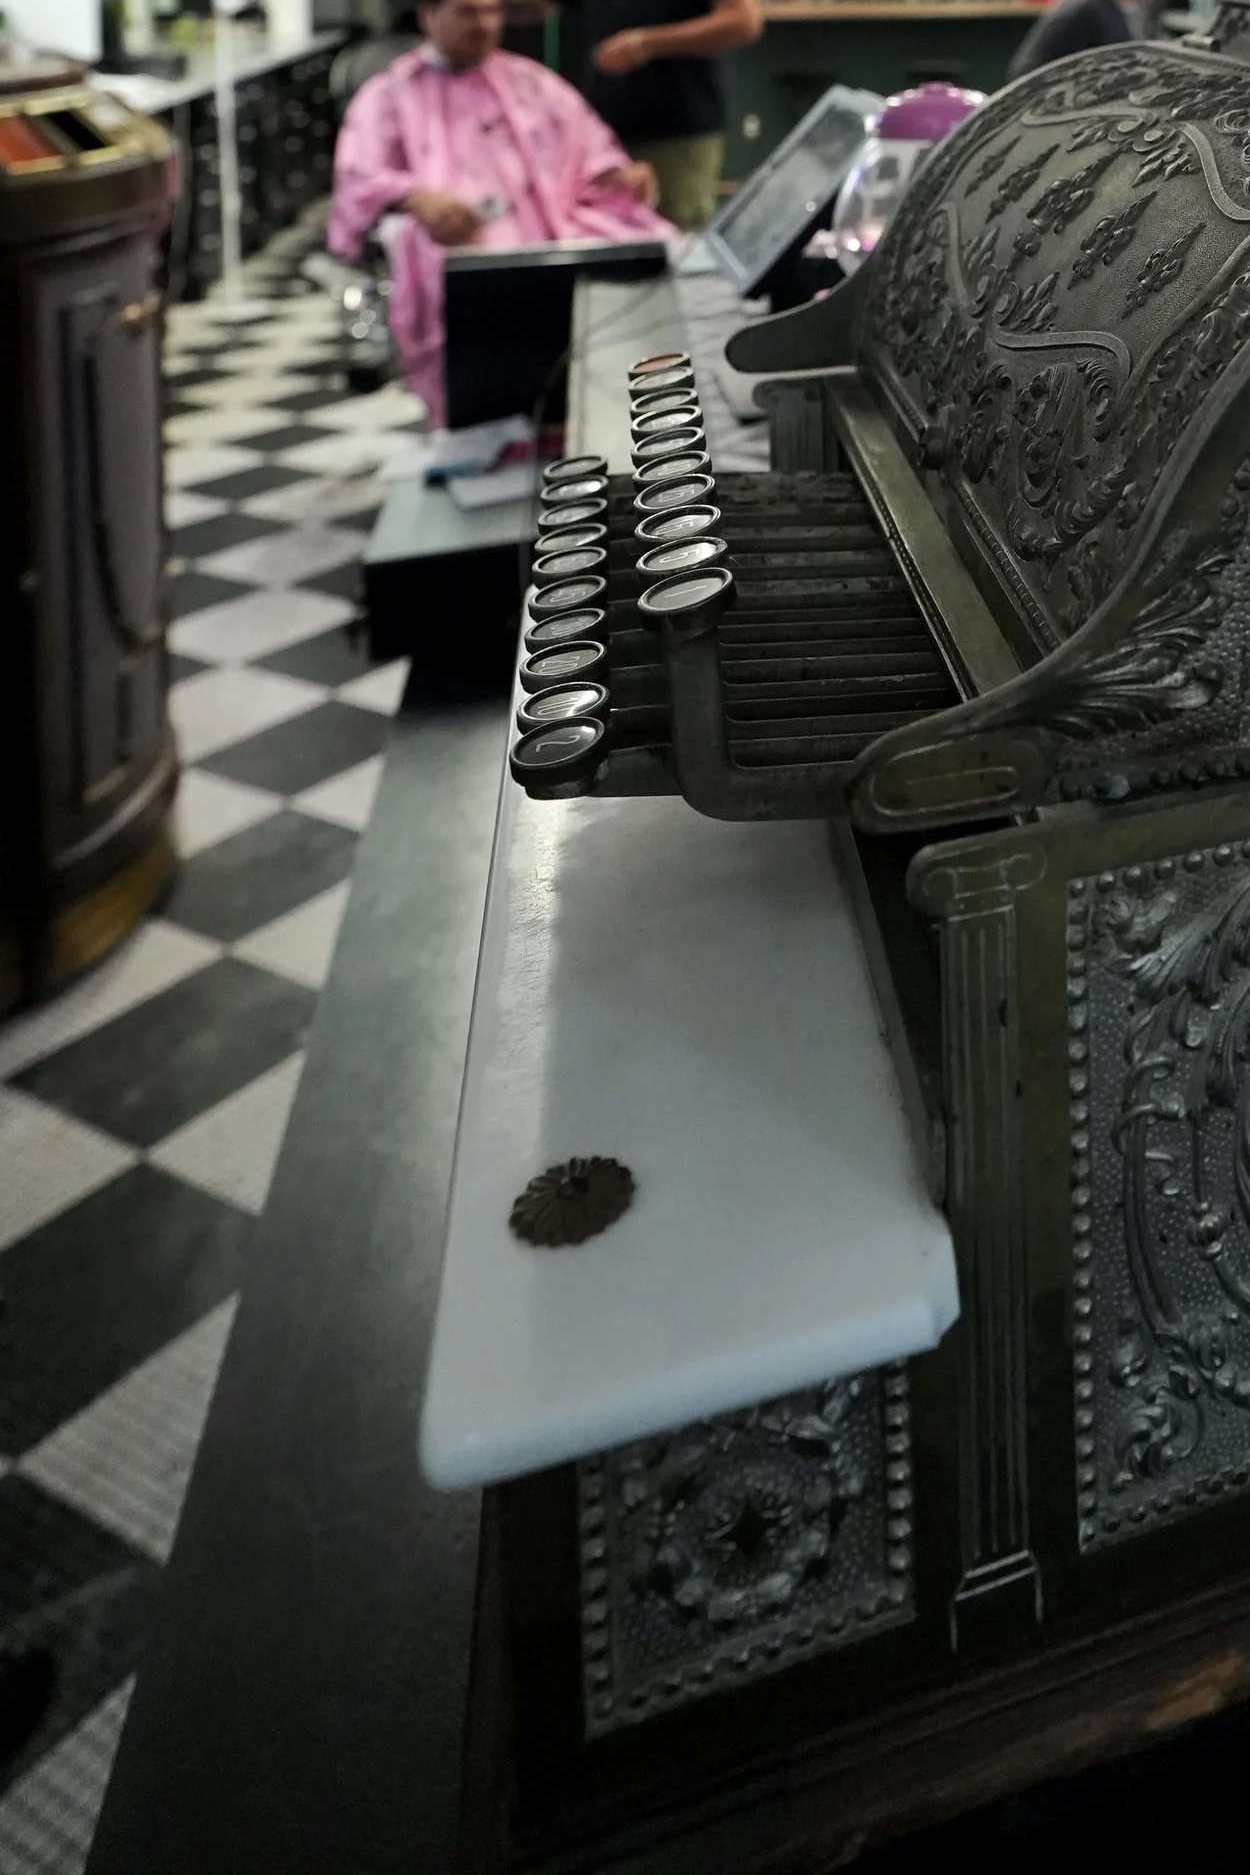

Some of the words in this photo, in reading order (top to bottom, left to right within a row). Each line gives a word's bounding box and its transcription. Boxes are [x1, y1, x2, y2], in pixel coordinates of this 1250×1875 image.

[658, 548, 700, 563] 5
[539, 655, 581, 675] 20
[537, 697, 580, 716] 10
[535, 734, 581, 753] 2
